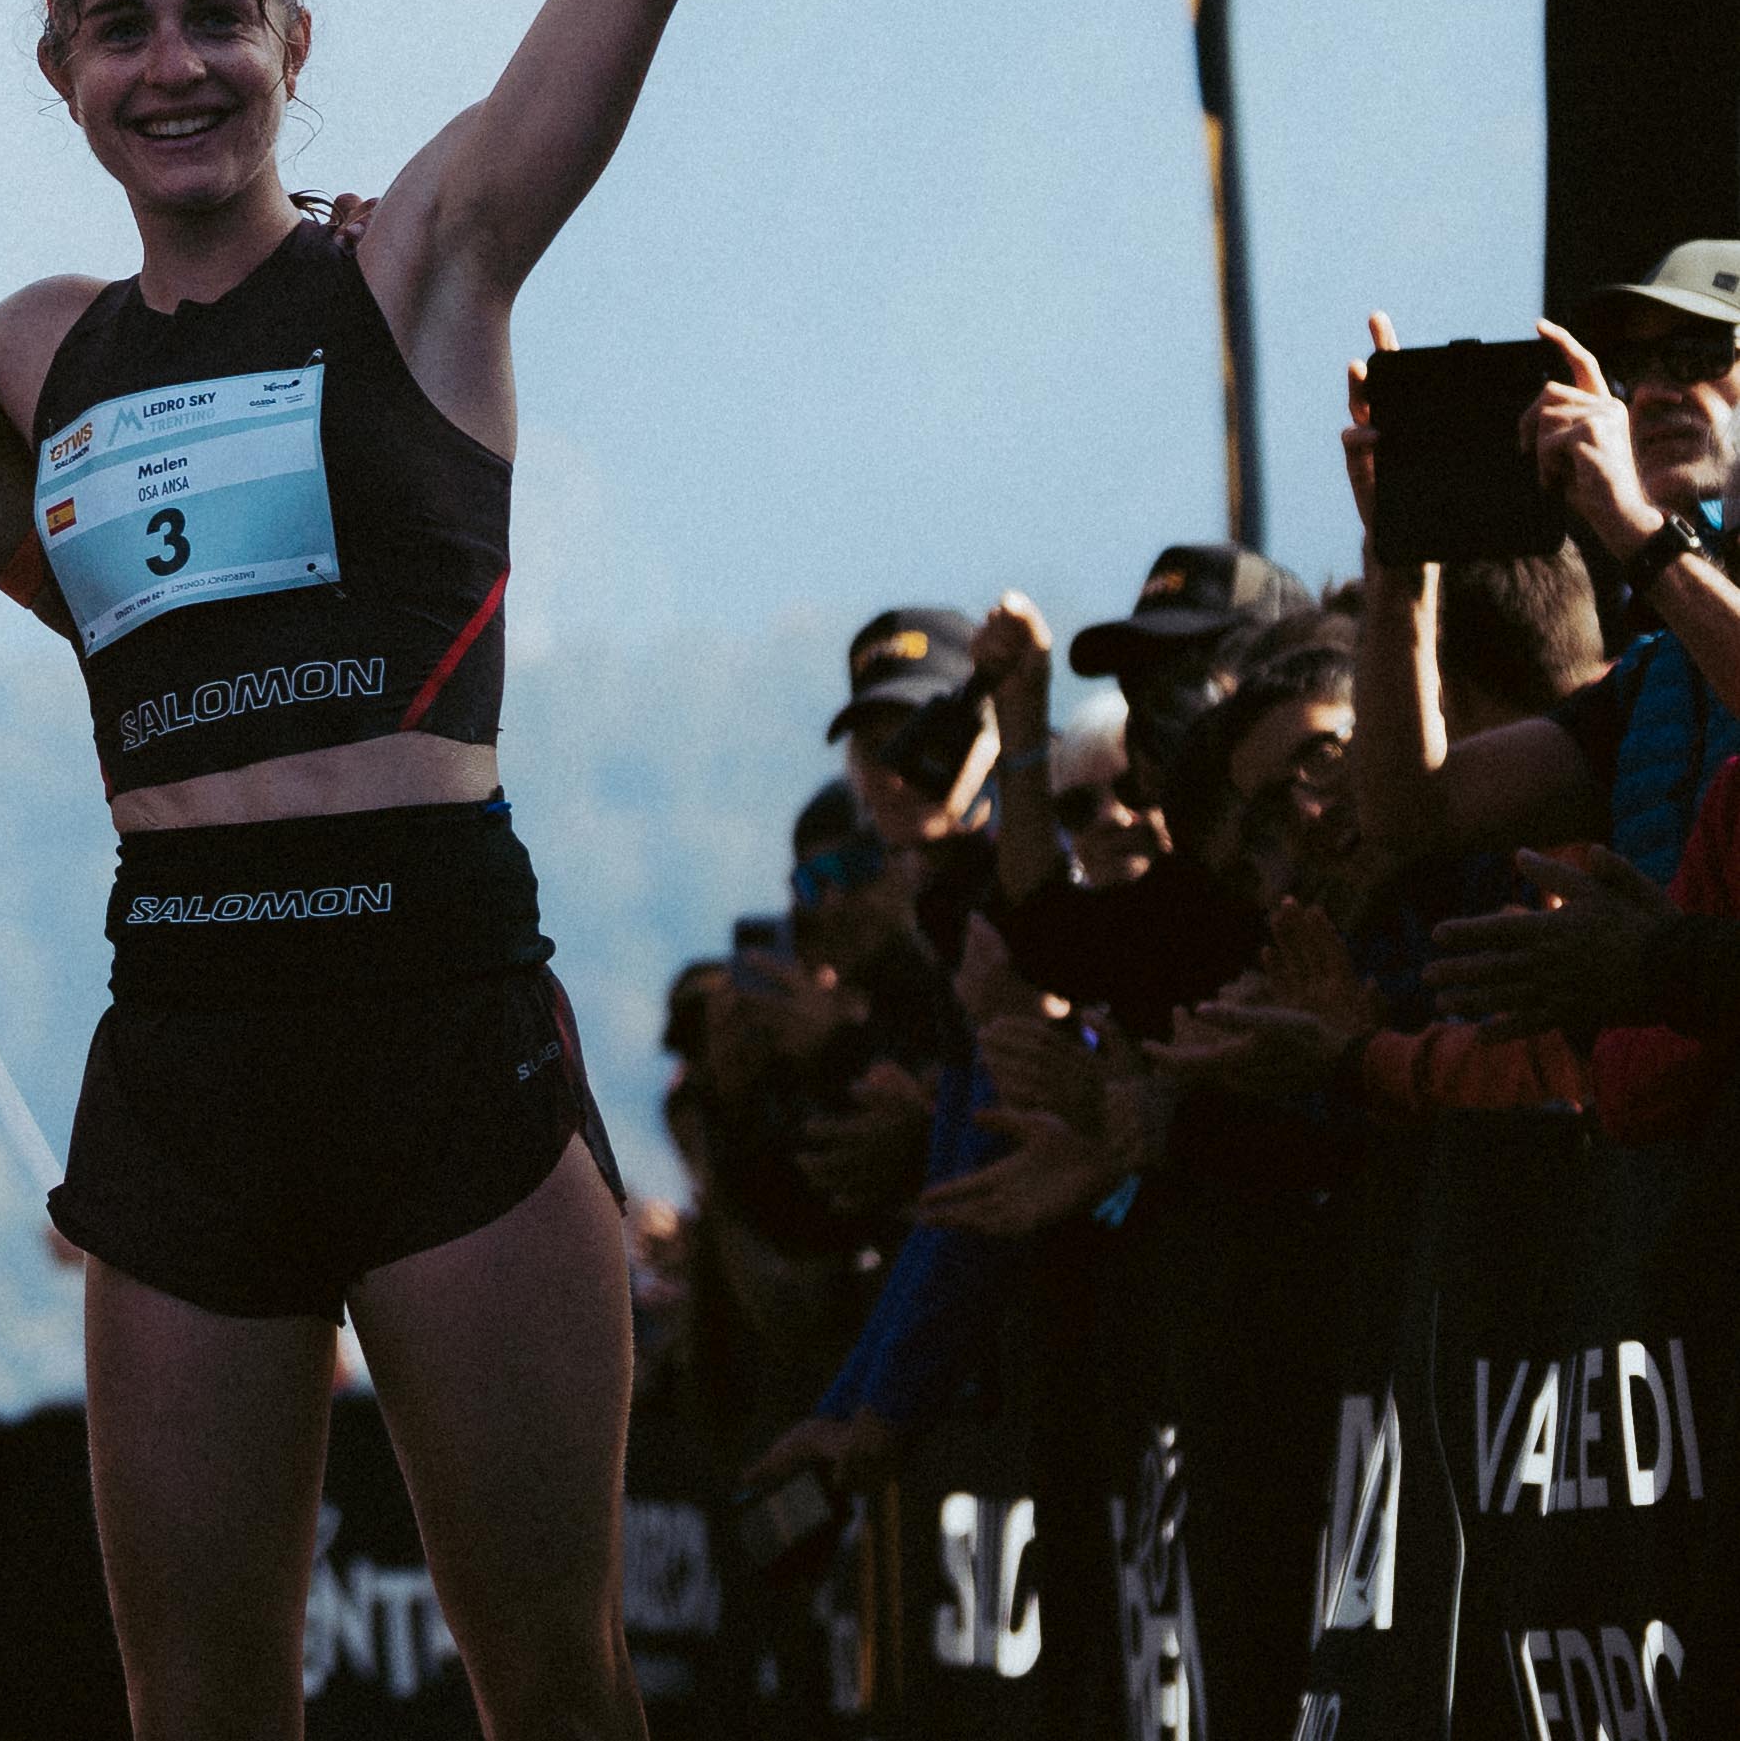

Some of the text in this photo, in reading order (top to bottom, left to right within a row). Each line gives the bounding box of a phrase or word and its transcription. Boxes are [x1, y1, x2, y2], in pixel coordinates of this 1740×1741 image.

[143, 391, 217, 419] LEDRO SKY
[150, 407, 216, 433] TRENTINO
[49, 422, 93, 462] GTWS
[137, 455, 189, 479] Malen
[138, 476, 190, 503] OSA ANSA
[145, 507, 191, 577] 3
[120, 657, 385, 752] SALOMON
[126, 882, 392, 924] SALOMON
